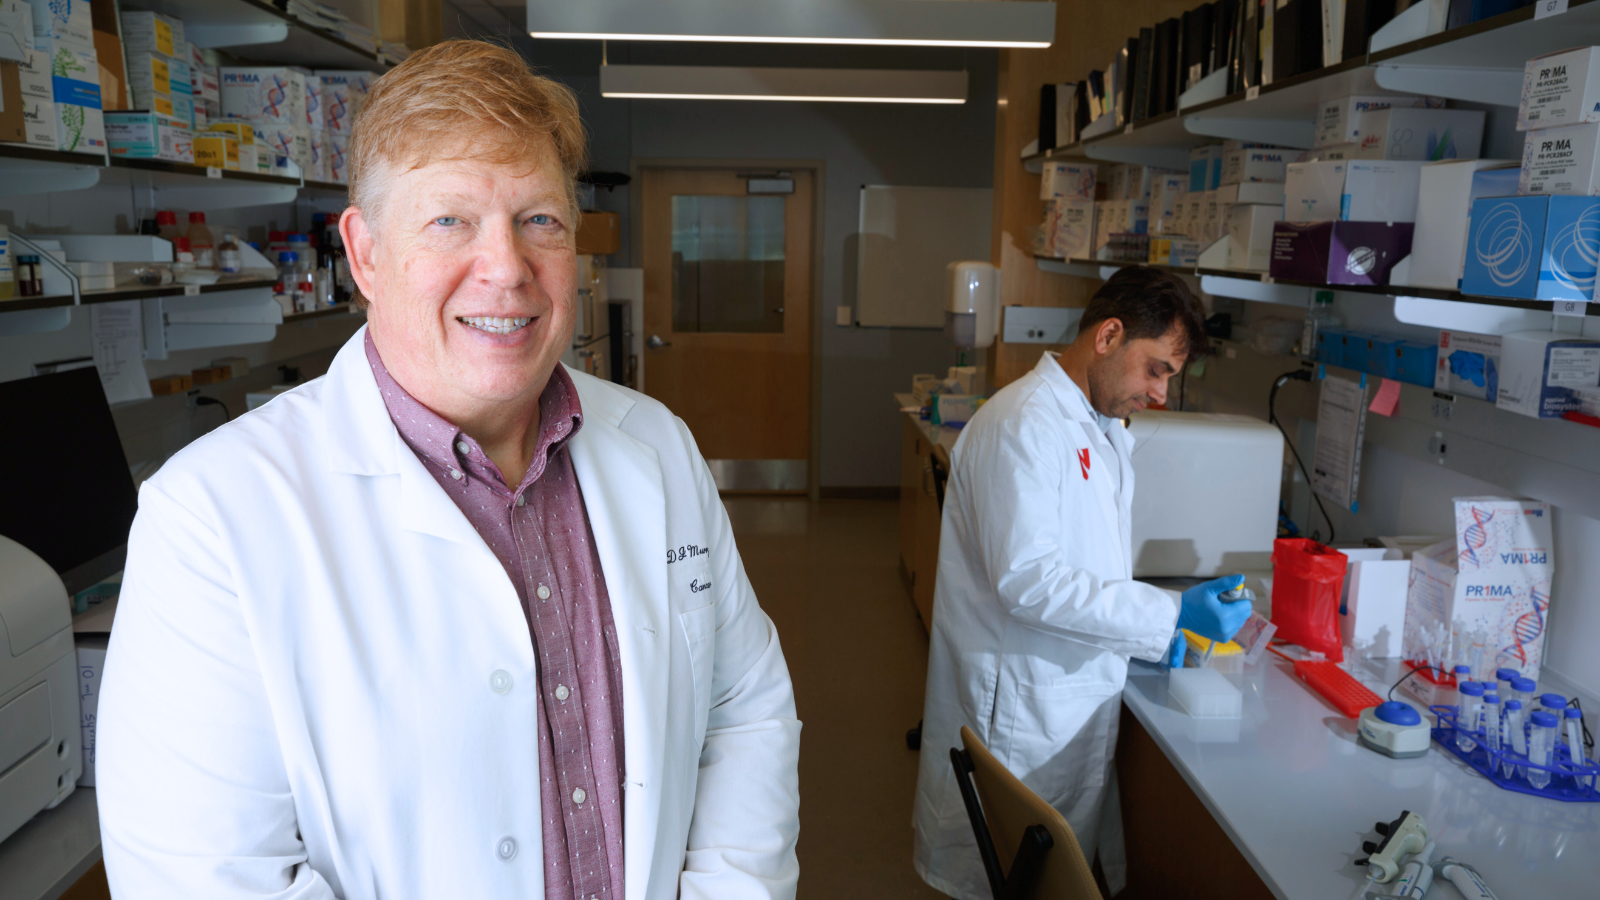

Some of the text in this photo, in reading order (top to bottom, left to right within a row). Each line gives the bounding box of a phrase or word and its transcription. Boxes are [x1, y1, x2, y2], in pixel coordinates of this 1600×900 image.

[1547, 1, 1557, 11] G7
[1252, 154, 1282, 163] PR1MA
[1565, 302, 1575, 312] G8
[666, 549, 677, 564] D
[1500, 552, 1547, 565] PR1MA
[1466, 585, 1513, 597] PR1MA
[80, 666, 94, 679] 10
